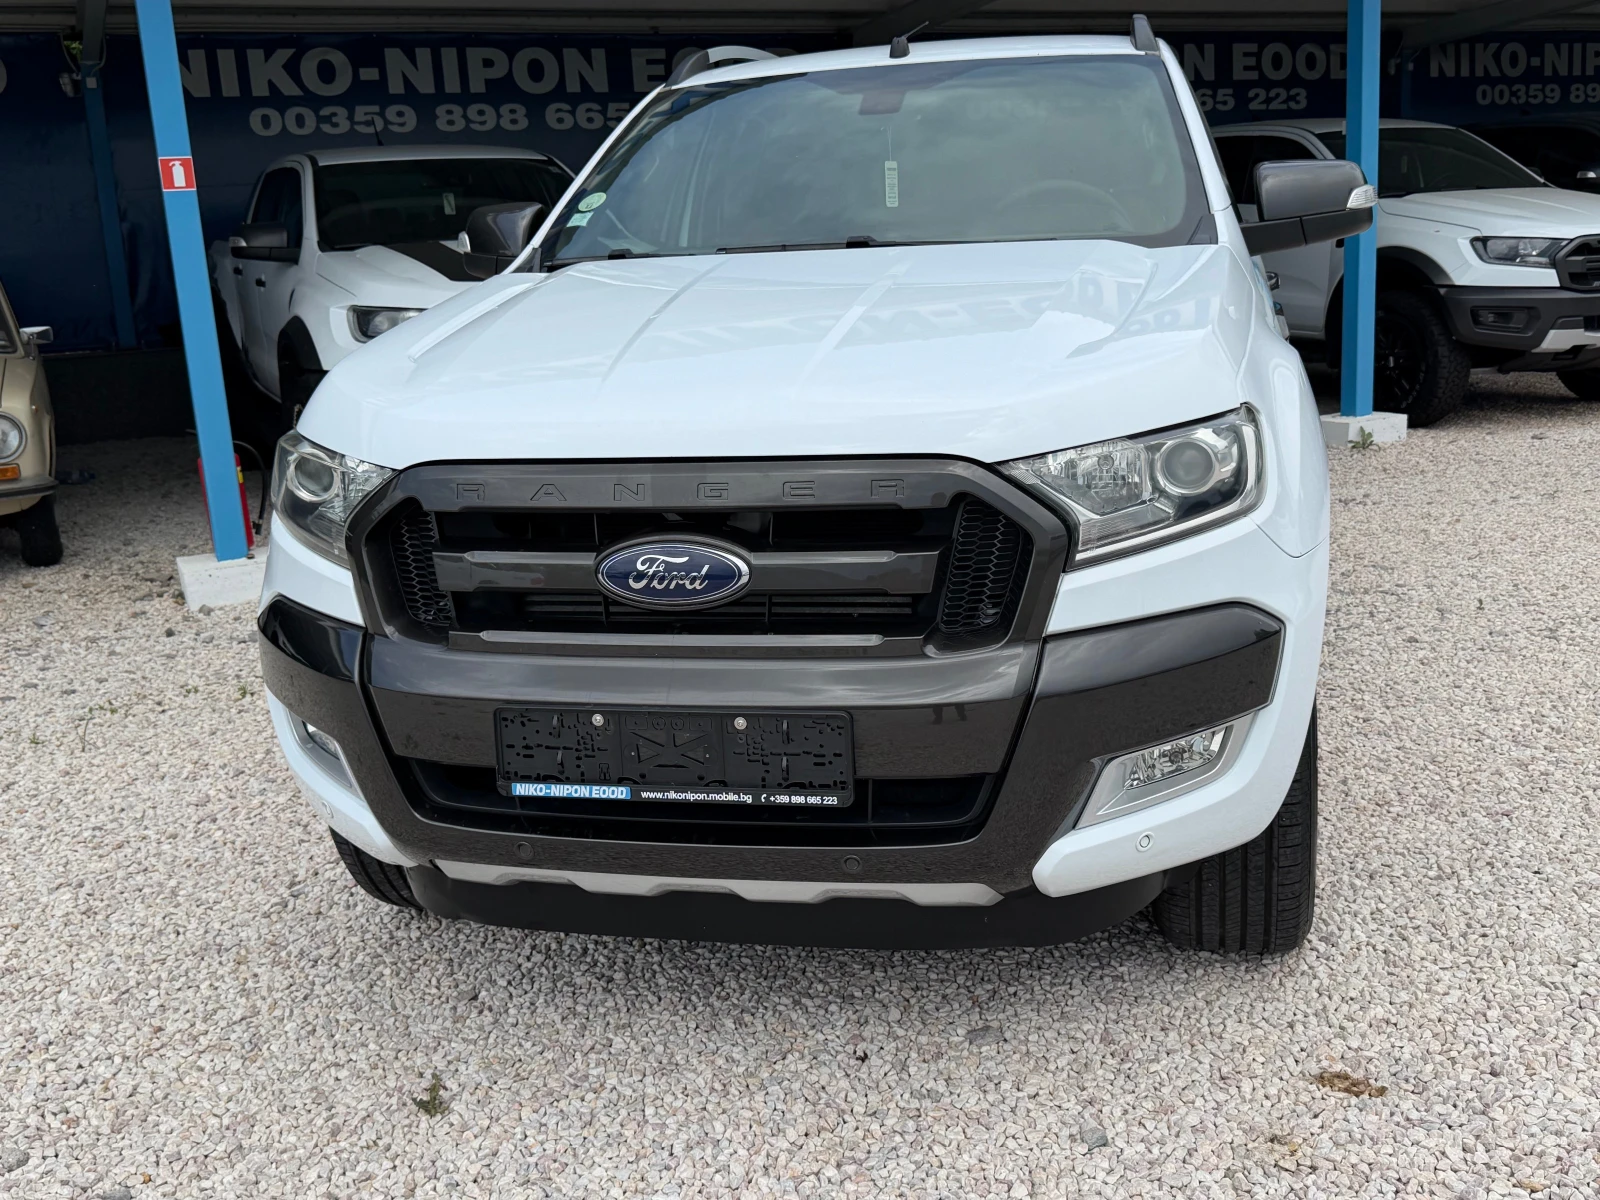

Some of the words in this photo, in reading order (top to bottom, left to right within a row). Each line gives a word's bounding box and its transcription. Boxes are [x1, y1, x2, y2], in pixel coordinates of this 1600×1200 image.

[180, 46, 609, 98] NIKO-NIPON
[1247, 87, 1308, 111] 223
[1475, 83, 1562, 106] 00359
[249, 104, 417, 137] 00359
[436, 102, 529, 133] 898
[456, 478, 905, 502] RANGER
[628, 554, 709, 590] Ford
[516, 783, 589, 798] NIKO-NIPON
[592, 786, 626, 799] EOOD
[641, 790, 753, 804] www.nikonipon.mobile.bg
[769, 795, 789, 804] +359
[790, 795, 806, 804] 898
[807, 796, 822, 805] 665
[823, 796, 838, 805] 223
